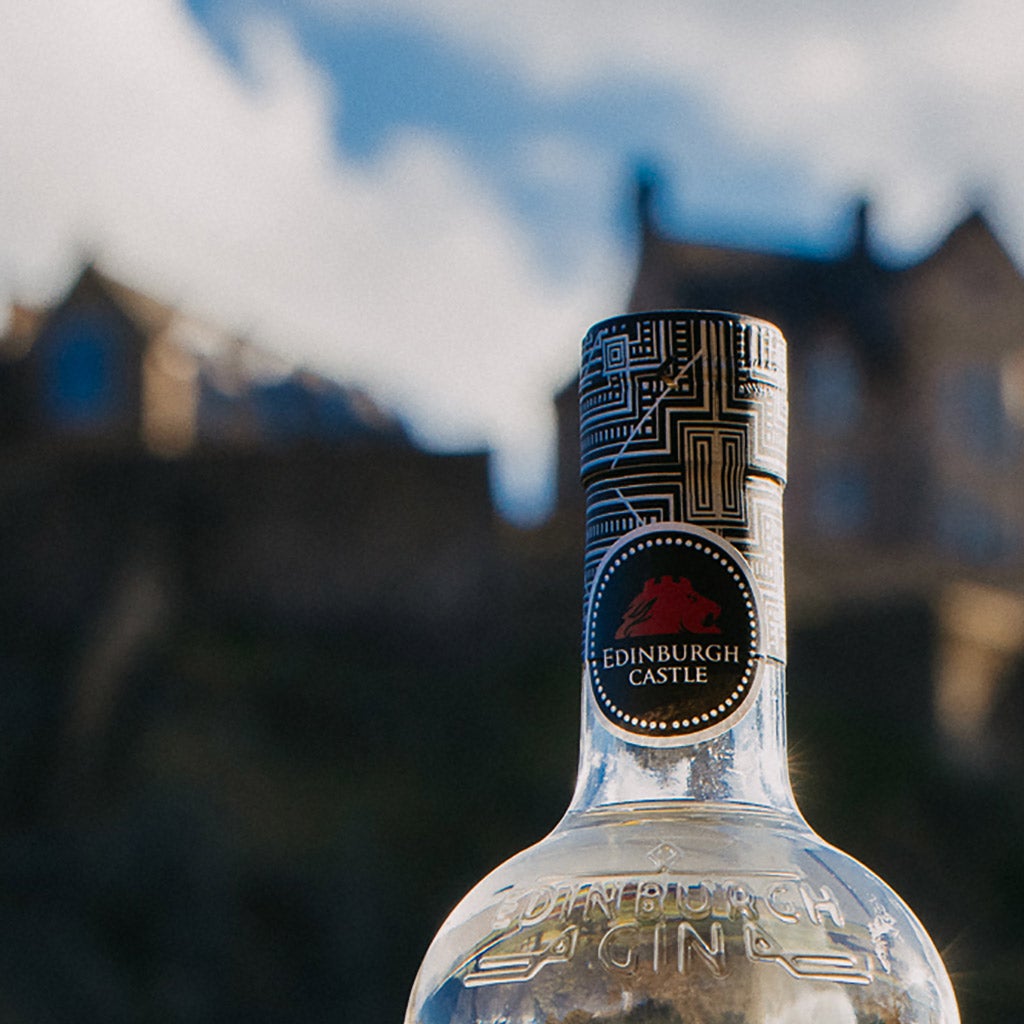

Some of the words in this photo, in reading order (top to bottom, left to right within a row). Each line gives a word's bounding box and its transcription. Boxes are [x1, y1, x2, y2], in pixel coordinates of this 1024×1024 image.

[603, 644, 740, 669] EDINBURGH
[629, 666, 709, 686] CASTLE
[598, 921, 732, 980] GIN
